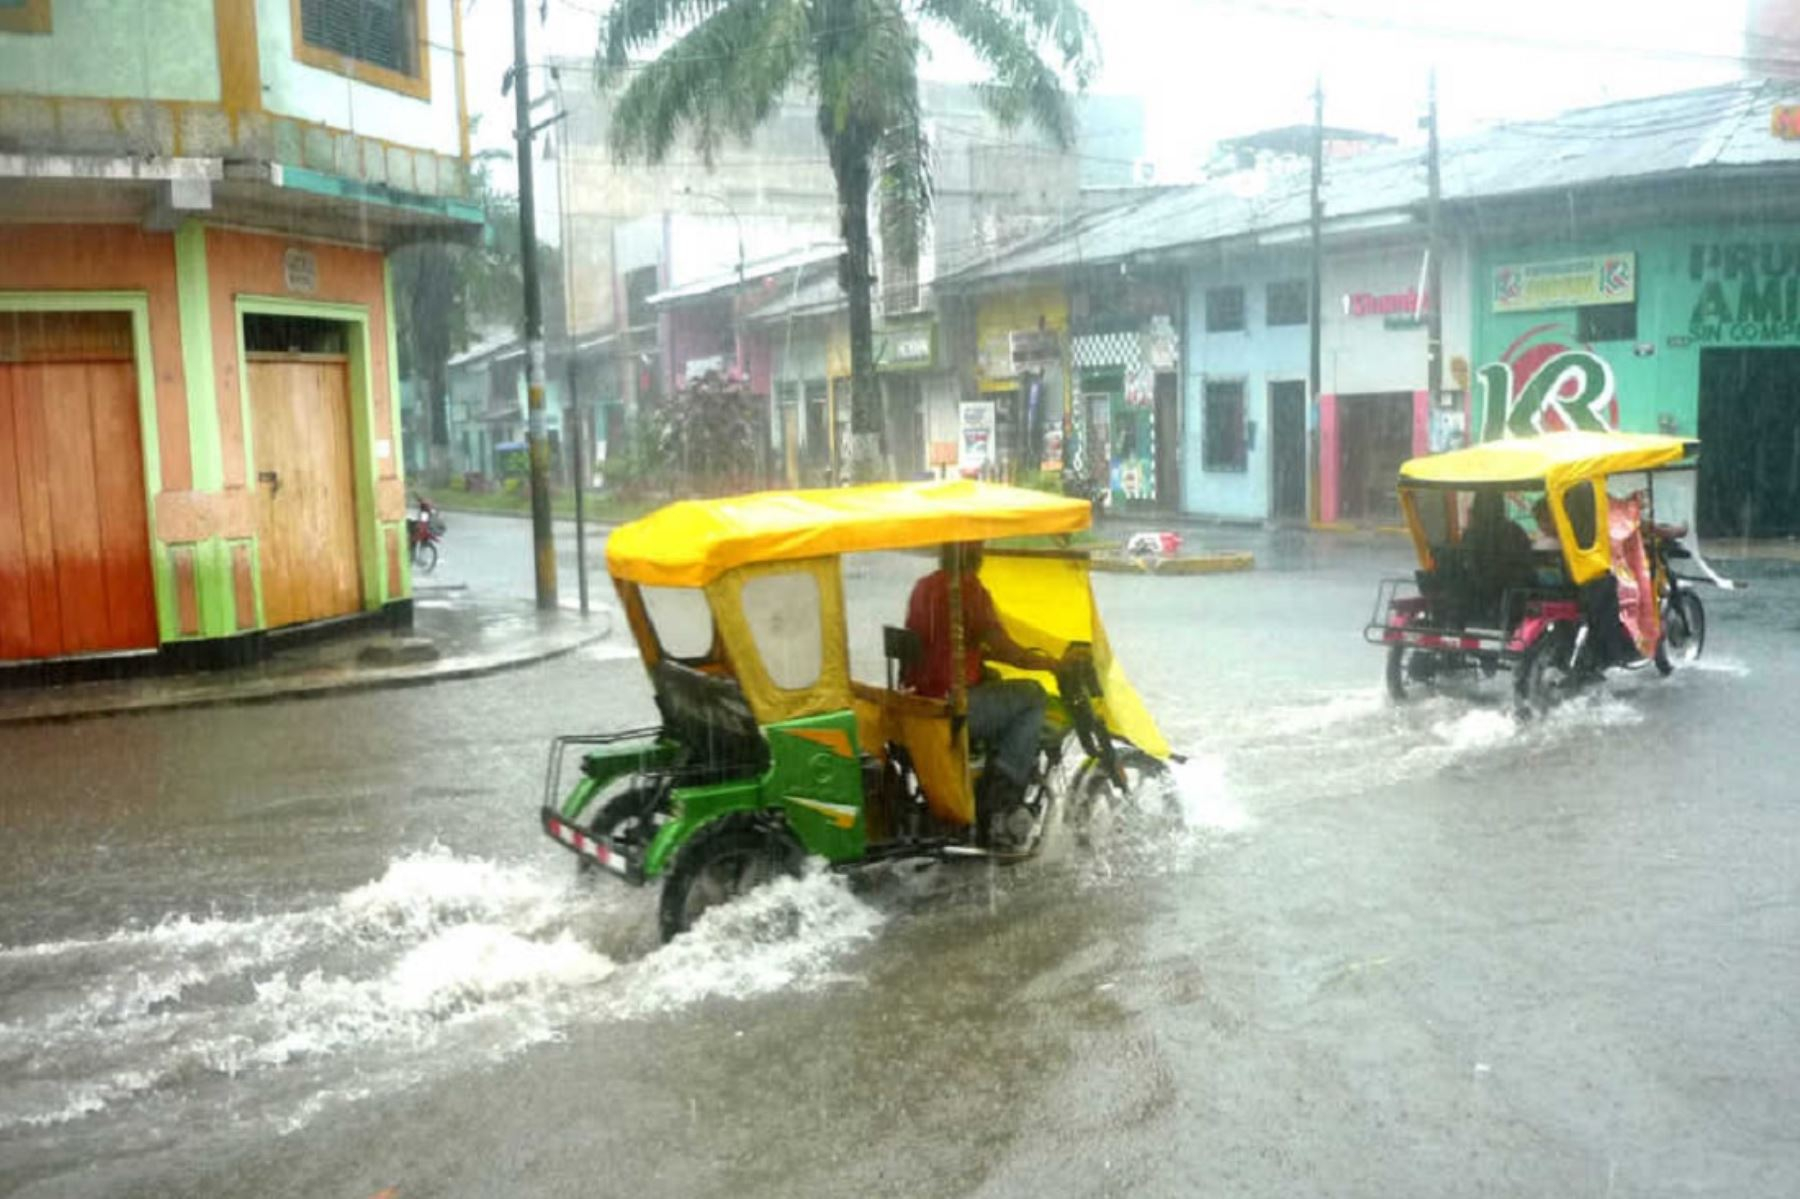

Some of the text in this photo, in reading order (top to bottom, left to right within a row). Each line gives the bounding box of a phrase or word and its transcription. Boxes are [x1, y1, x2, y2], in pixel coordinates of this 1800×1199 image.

[1689, 243, 1800, 281] PRU
[1688, 321, 1722, 342] SIN
[1729, 322, 1800, 342] COMP
